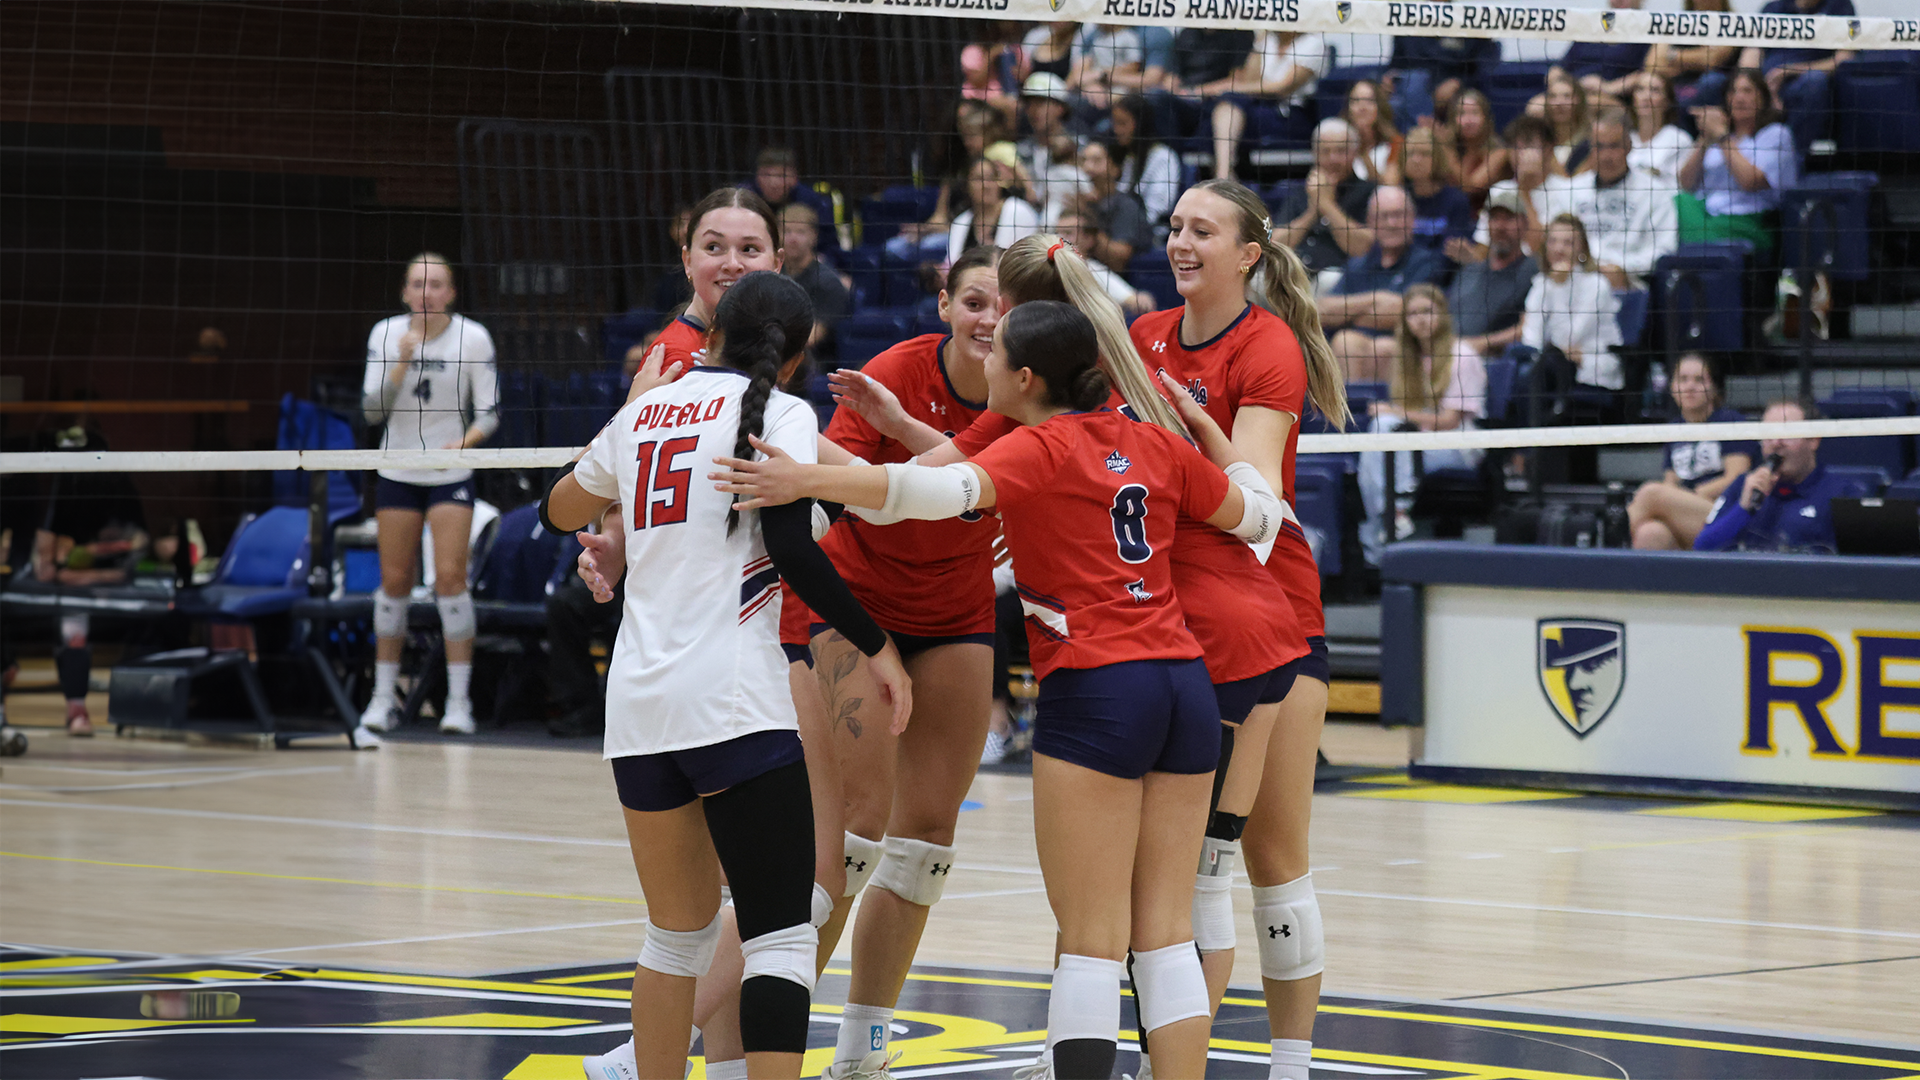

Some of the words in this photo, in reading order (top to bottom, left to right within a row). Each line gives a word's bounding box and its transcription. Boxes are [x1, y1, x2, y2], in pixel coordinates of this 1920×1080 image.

[1103, 0, 1176, 17] REGIS
[1185, 0, 1299, 22] RANGERS
[1387, 3, 1454, 28] REGIS
[1460, 6, 1567, 31] RANGERS
[1647, 12, 1709, 37] REGIS
[1717, 15, 1815, 40] RANGERS
[1891, 20, 1920, 42] RE
[633, 396, 726, 432] PUEBLO
[1105, 456, 1131, 469] RMAC
[634, 434, 701, 532] 15
[1109, 484, 1153, 564] 8
[1740, 625, 1920, 766] RE
